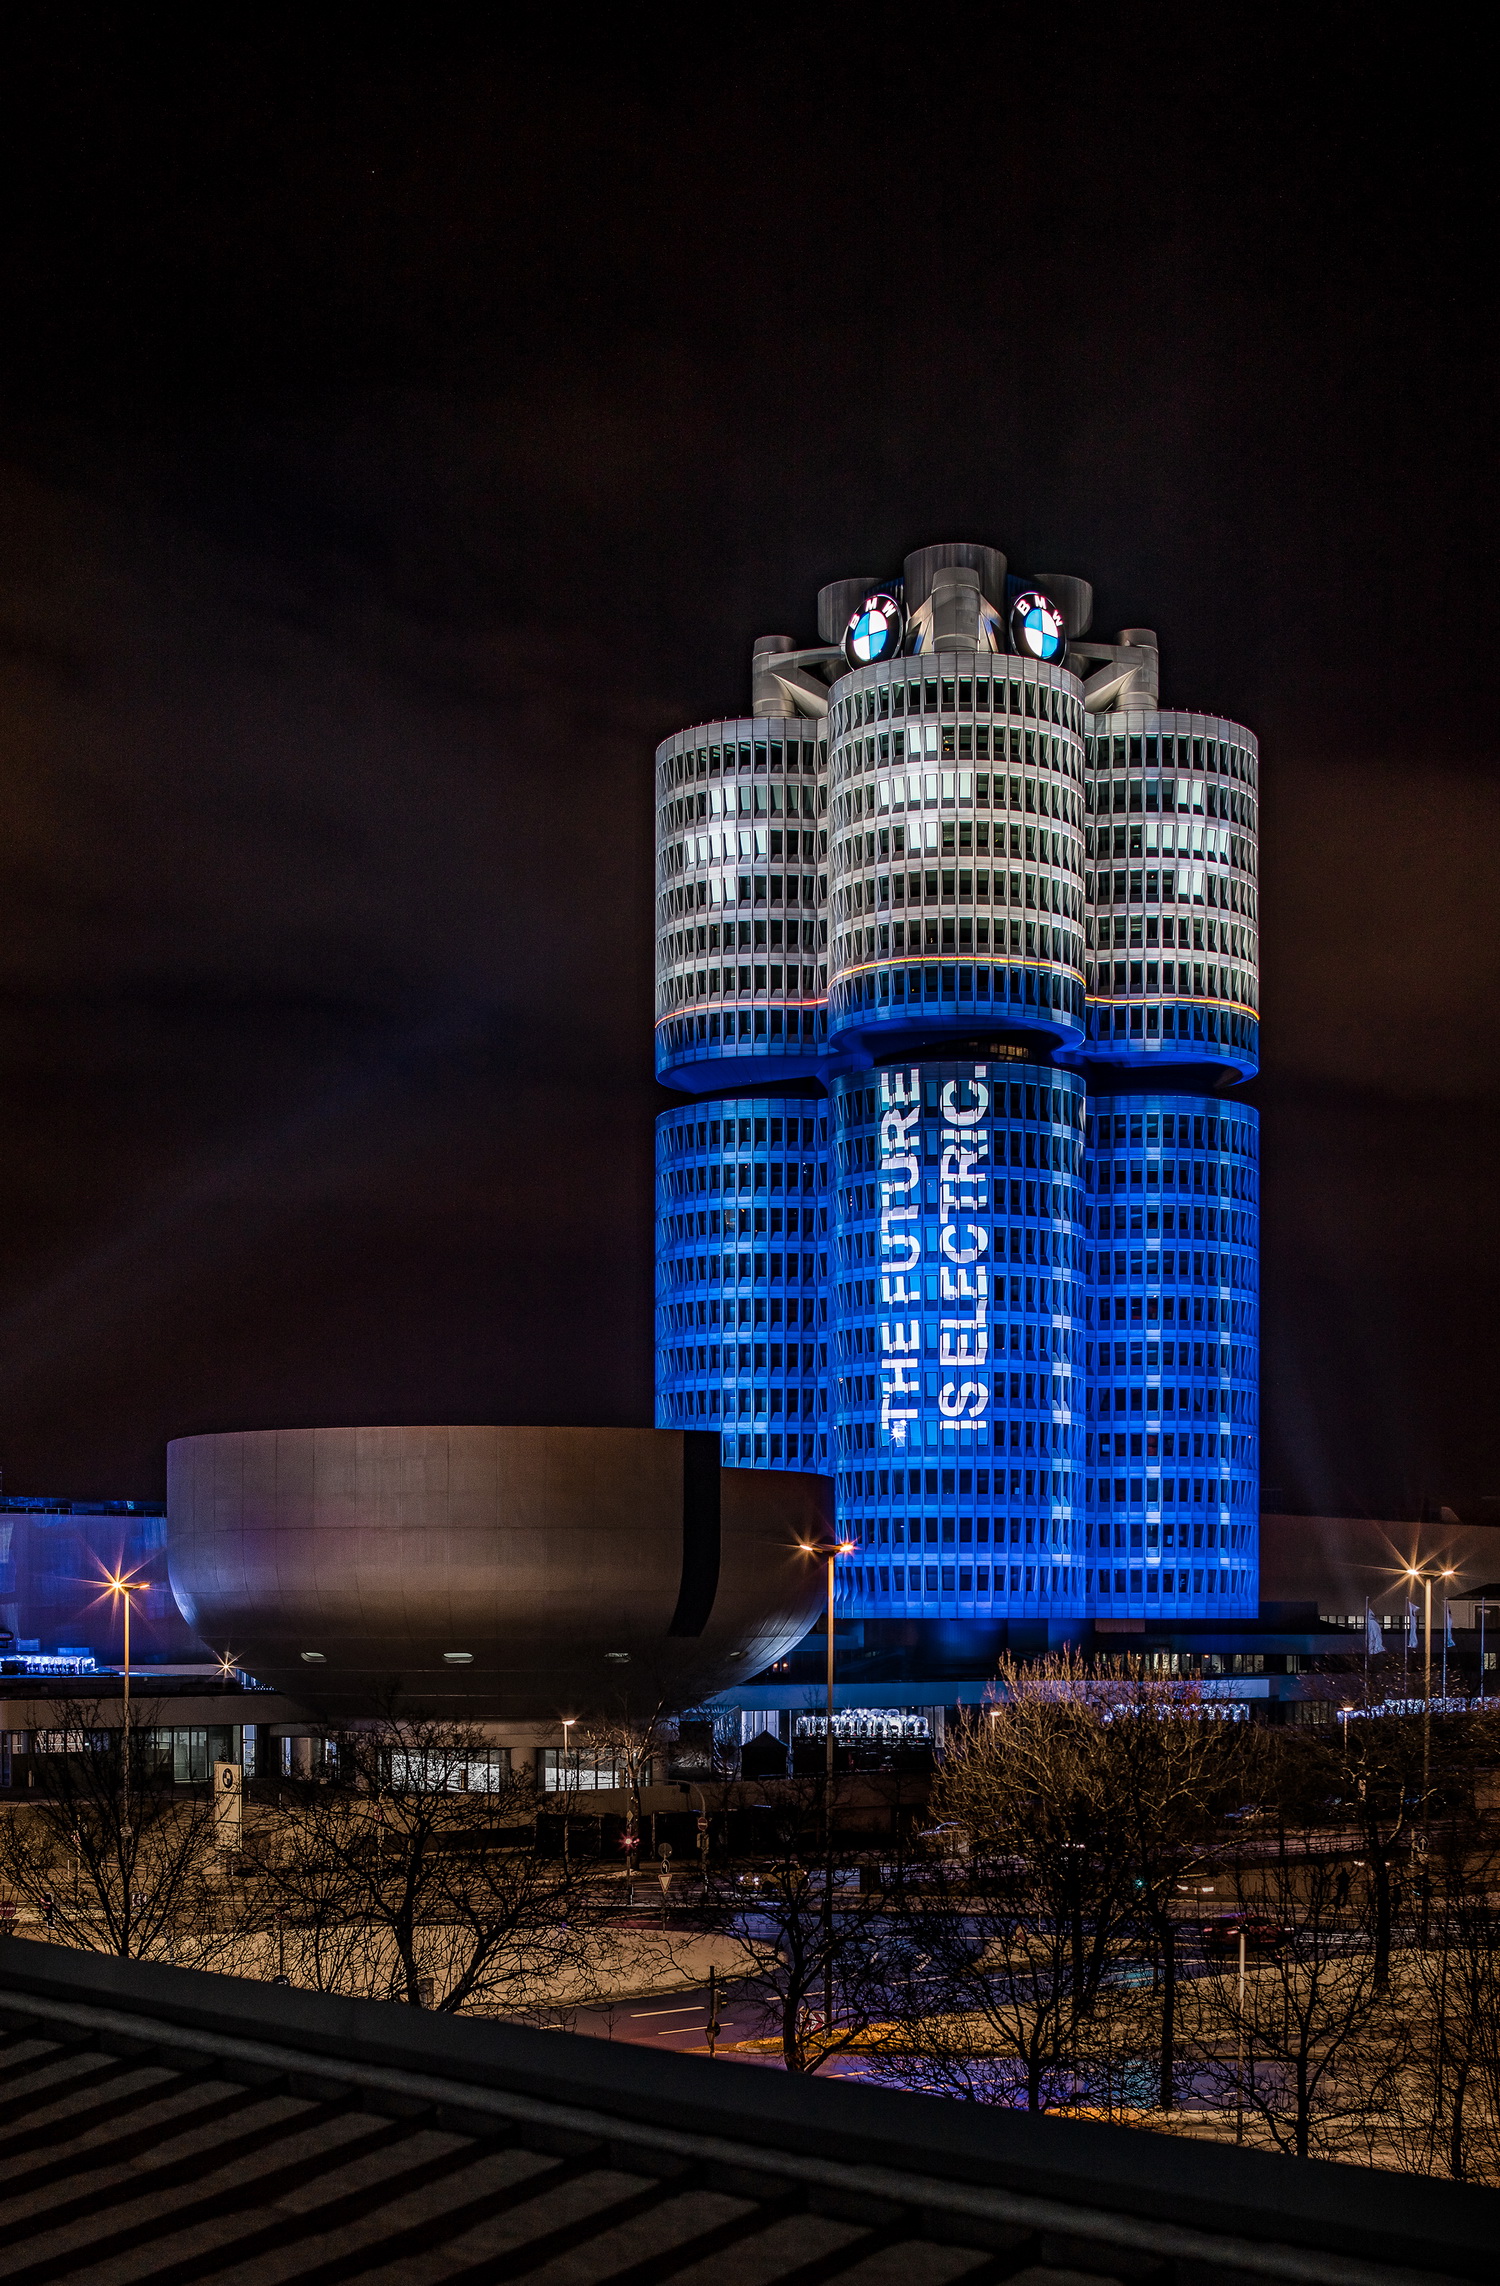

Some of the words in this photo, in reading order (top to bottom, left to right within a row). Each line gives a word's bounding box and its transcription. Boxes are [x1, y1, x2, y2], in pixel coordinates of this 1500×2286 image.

[849, 597, 897, 631] BMW
[1015, 595, 1064, 628] BMW
[880, 1068, 921, 1304] FUTURE
[939, 1065, 990, 1366] ELECTRIC.
[881, 1319, 919, 1430] THE
[938, 1381, 990, 1431] IS
